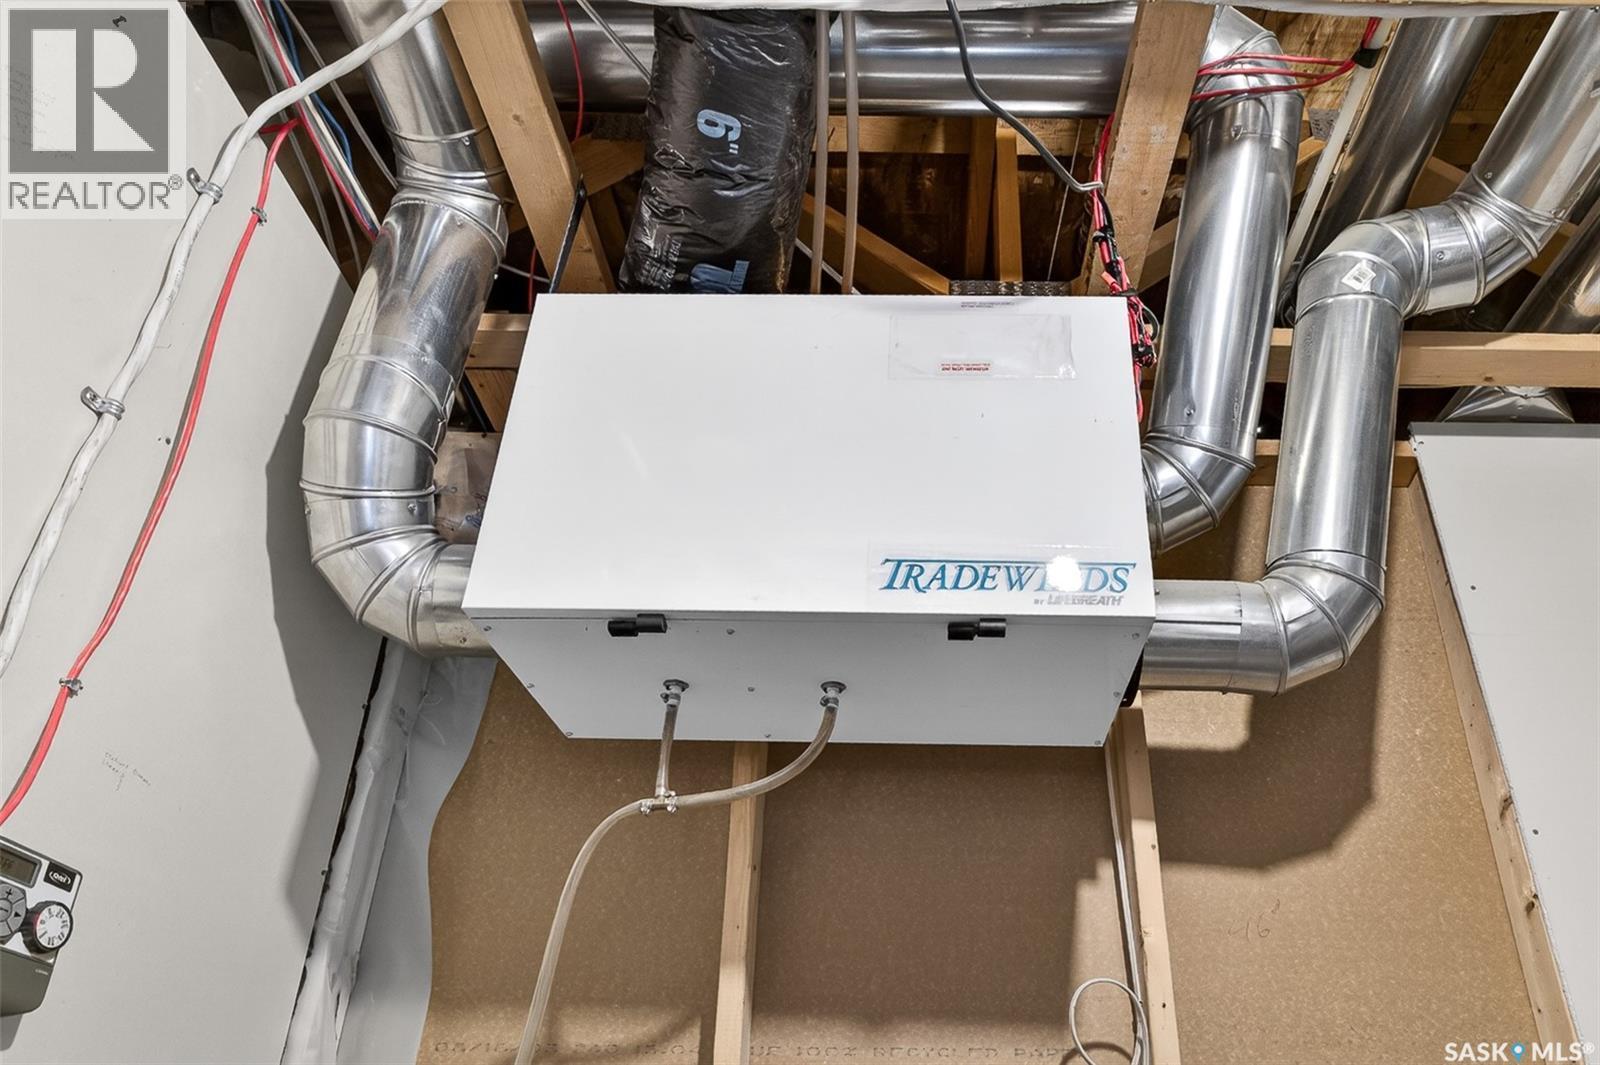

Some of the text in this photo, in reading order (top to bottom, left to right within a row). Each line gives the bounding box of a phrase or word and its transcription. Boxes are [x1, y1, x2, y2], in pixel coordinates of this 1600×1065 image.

[696, 108, 742, 155] 6"
[879, 557, 1137, 594] TRADEWIDS
[872, 1046, 1000, 1058] RECYCLED
